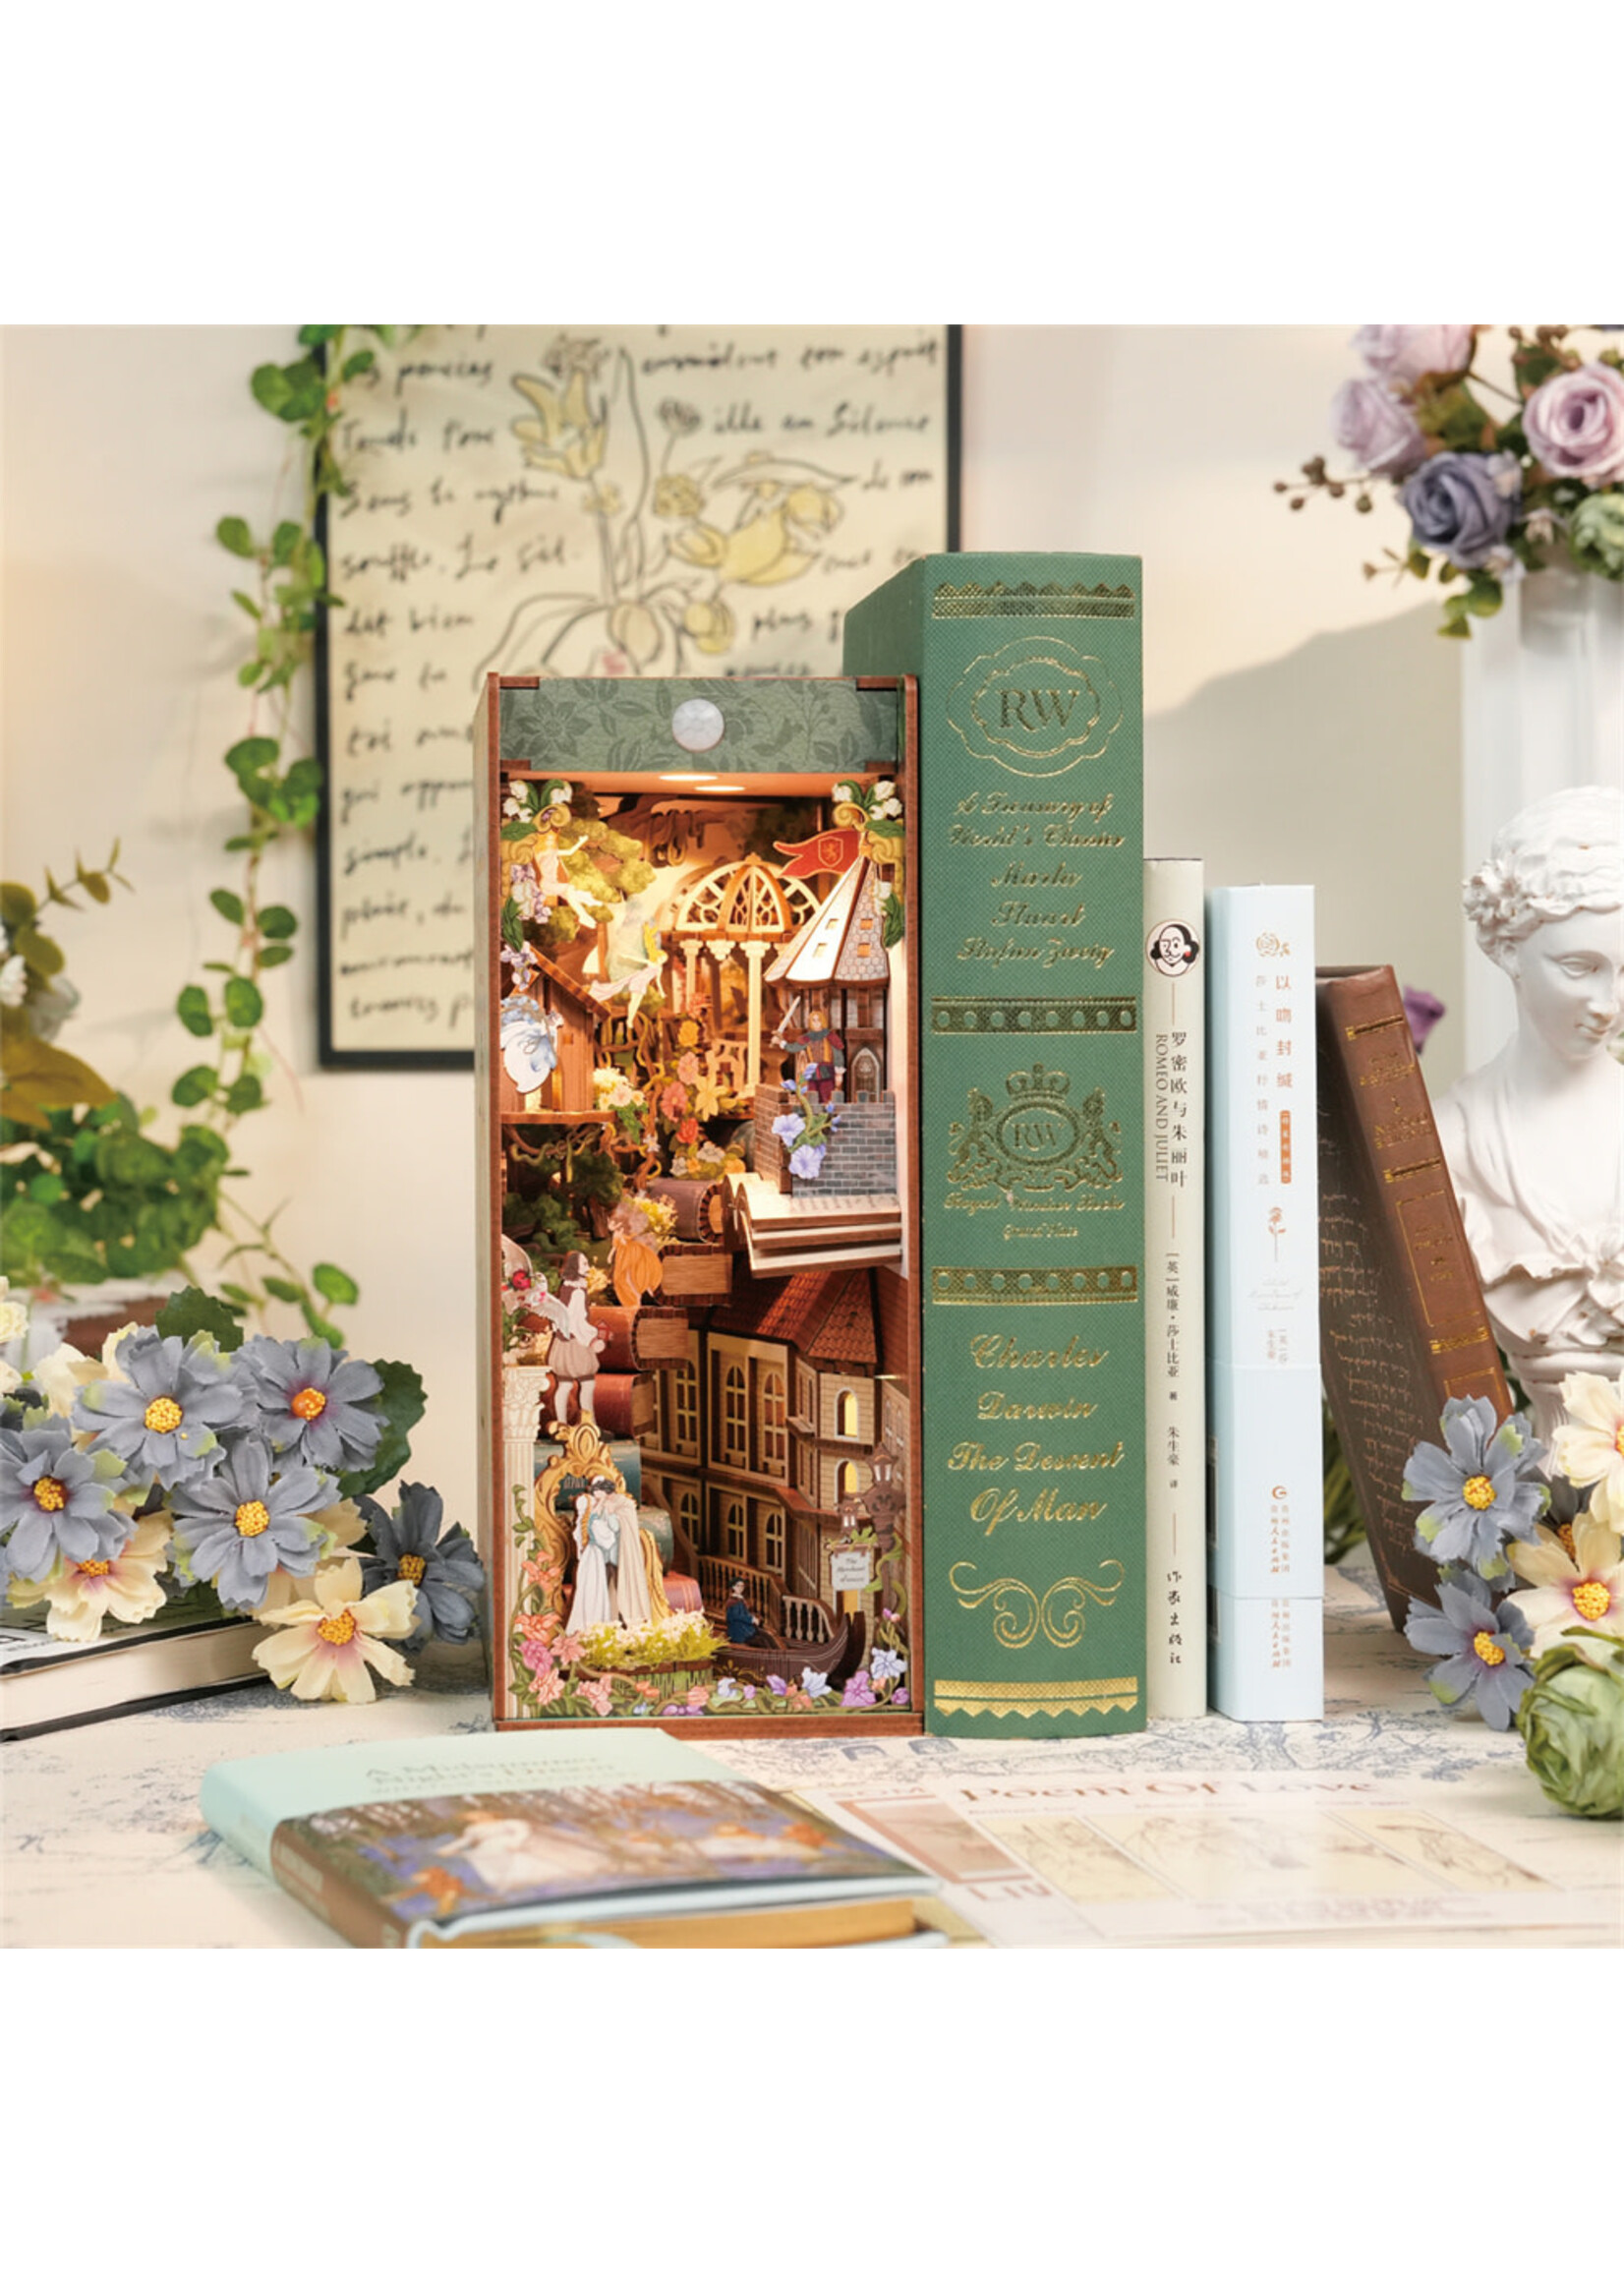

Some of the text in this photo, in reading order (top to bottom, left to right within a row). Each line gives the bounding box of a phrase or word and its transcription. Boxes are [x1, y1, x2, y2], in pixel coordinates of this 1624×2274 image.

[996, 689, 1079, 731] RW
[982, 791, 1085, 824] Treasury
[1087, 792, 1115, 824] of
[949, 823, 1032, 847] World's
[1043, 937, 1115, 968] Zweig
[1155, 1033, 1169, 1183] ROMEO AND JULIET
[1170, 1031, 1188, 1189] 罗密欧与朱丽叶
[970, 1333, 1109, 1369] Charles
[977, 1390, 1098, 1420] Darwin
[948, 1441, 1125, 1471] The Descent
[970, 1487, 1108, 1537] Of Man
[959, 1787, 1129, 1803] Poem
